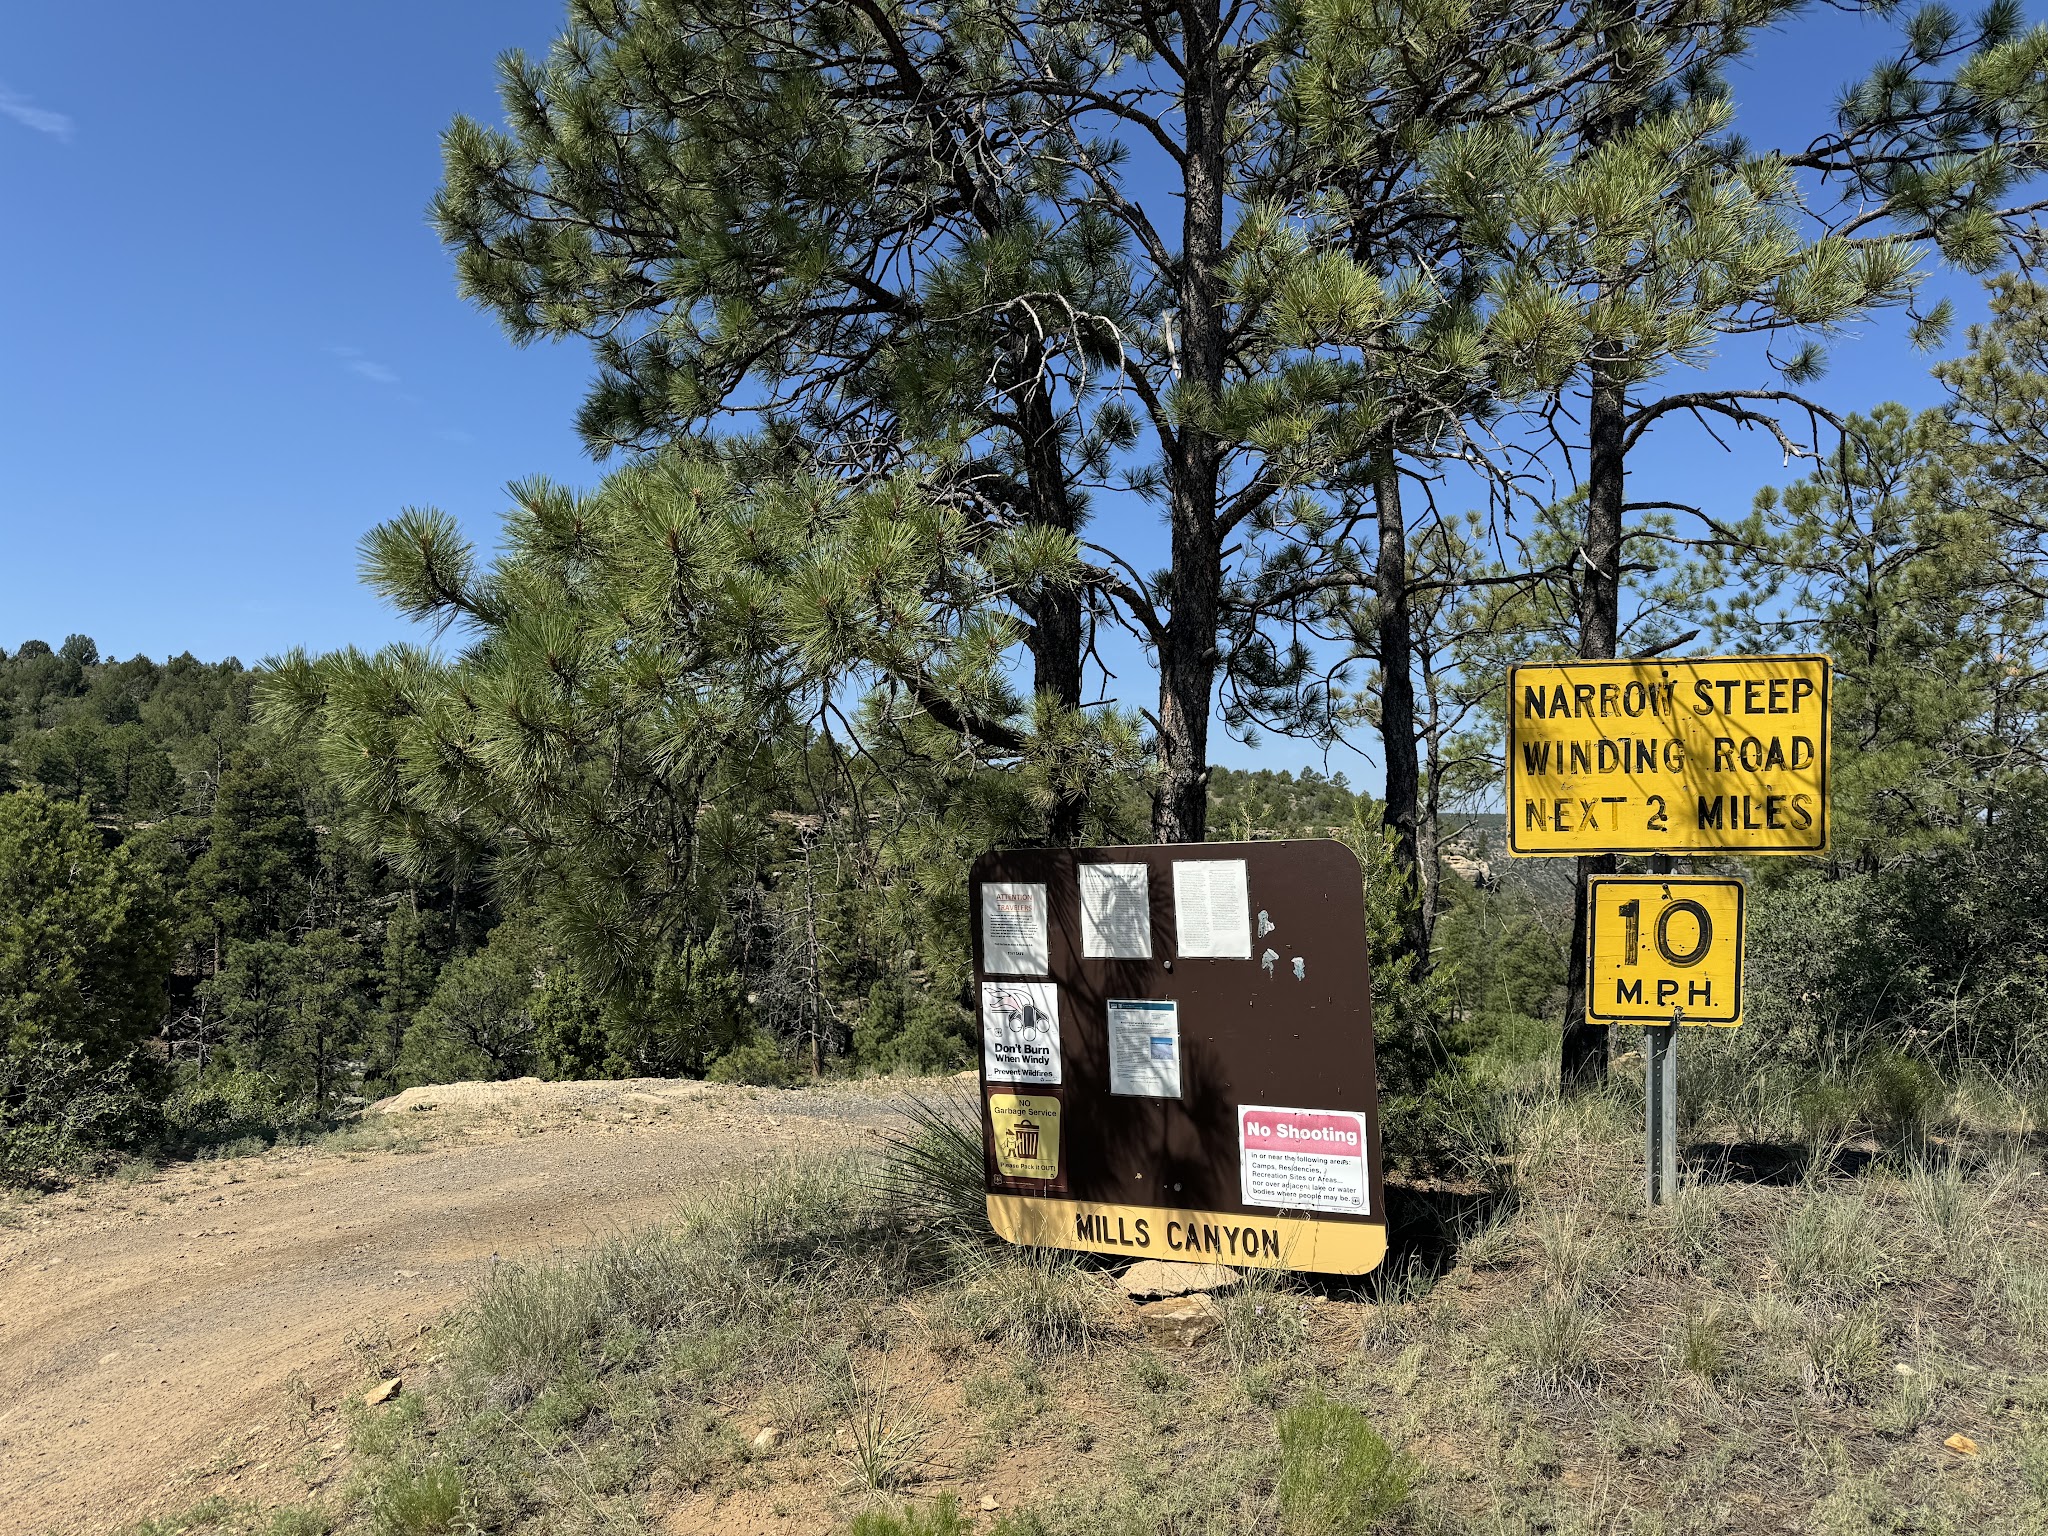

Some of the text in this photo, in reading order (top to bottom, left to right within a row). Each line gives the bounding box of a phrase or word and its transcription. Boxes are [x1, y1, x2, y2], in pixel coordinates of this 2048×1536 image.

[1524, 678, 1814, 719] NARROW STEEP
[1522, 736, 1814, 775] WINDING ROAD
[1526, 794, 1812, 832] NEXT 2 MILES
[1618, 898, 1713, 968] 10
[1616, 979, 1719, 1006] M.P.H.
[995, 1043, 1049, 1054] Don't Burn
[995, 1054, 1049, 1065] When Windy
[995, 1107, 1026, 1116] Garbage
[1247, 1122, 1357, 1145] No Shooting
[1278, 1164, 1322, 1173] Residencies,
[1297, 1156, 1328, 1165] following
[1282, 1182, 1310, 1190] adjacent
[1076, 1213, 1280, 1259] MILLS CANYON
